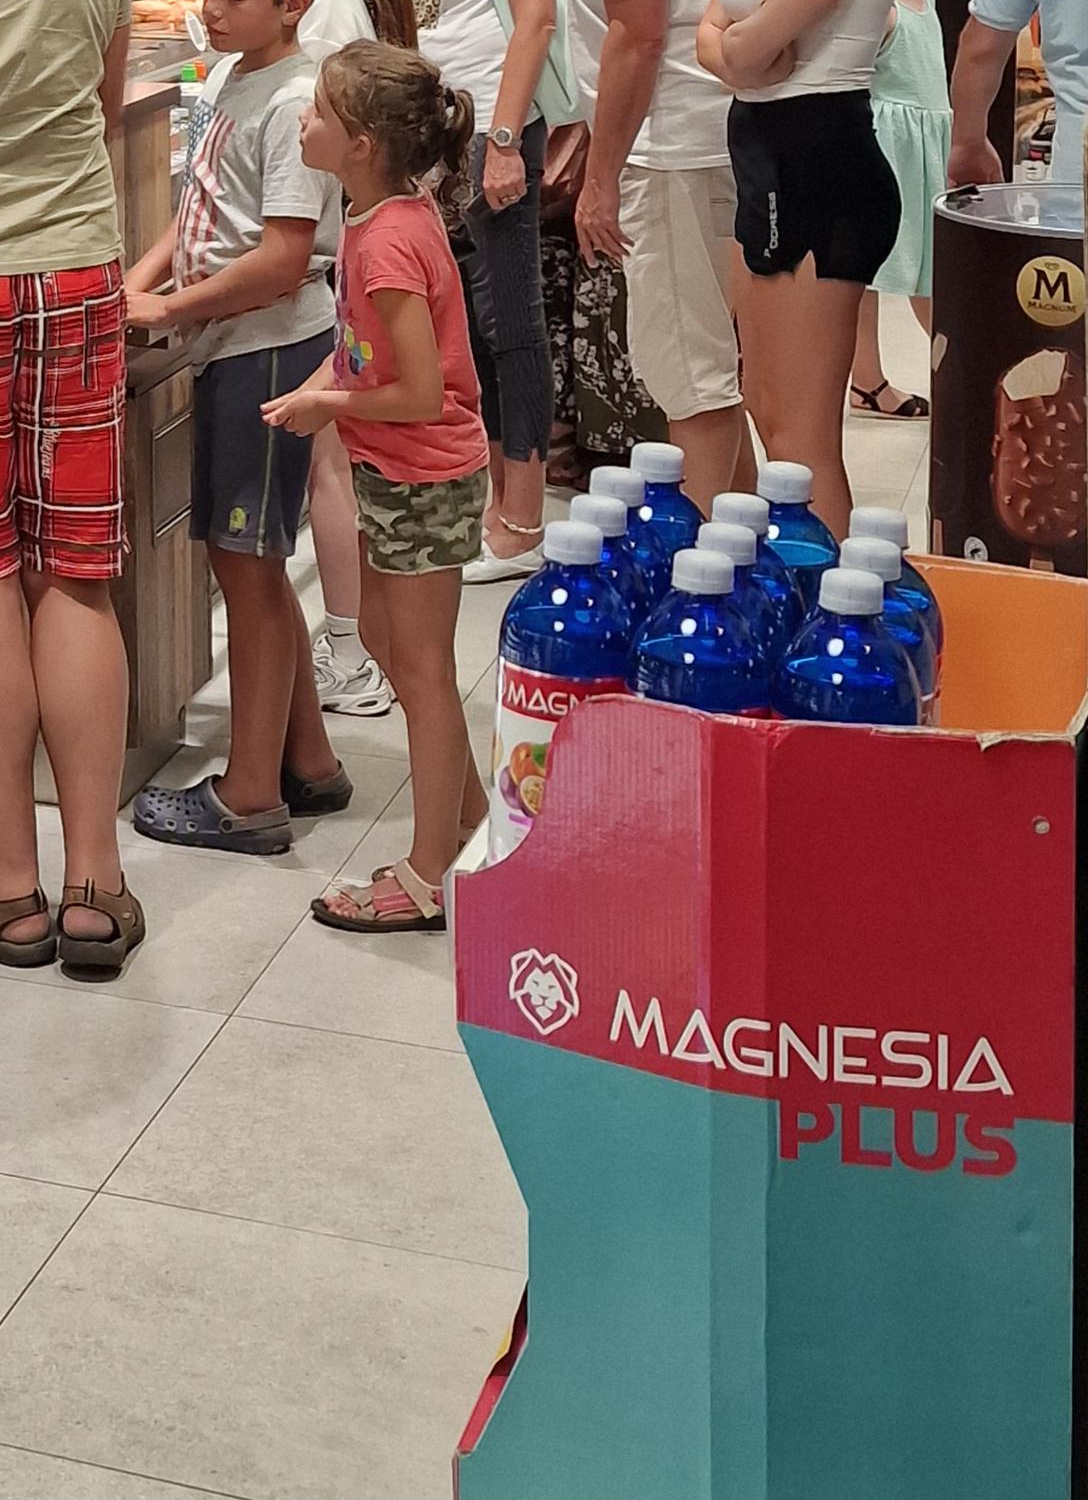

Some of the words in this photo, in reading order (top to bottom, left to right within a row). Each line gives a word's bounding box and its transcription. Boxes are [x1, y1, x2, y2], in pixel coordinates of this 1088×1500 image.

[507, 679, 589, 717] MAGN
[609, 989, 1014, 1096] MAGNESIA
[780, 1100, 1018, 1178] PLUS
